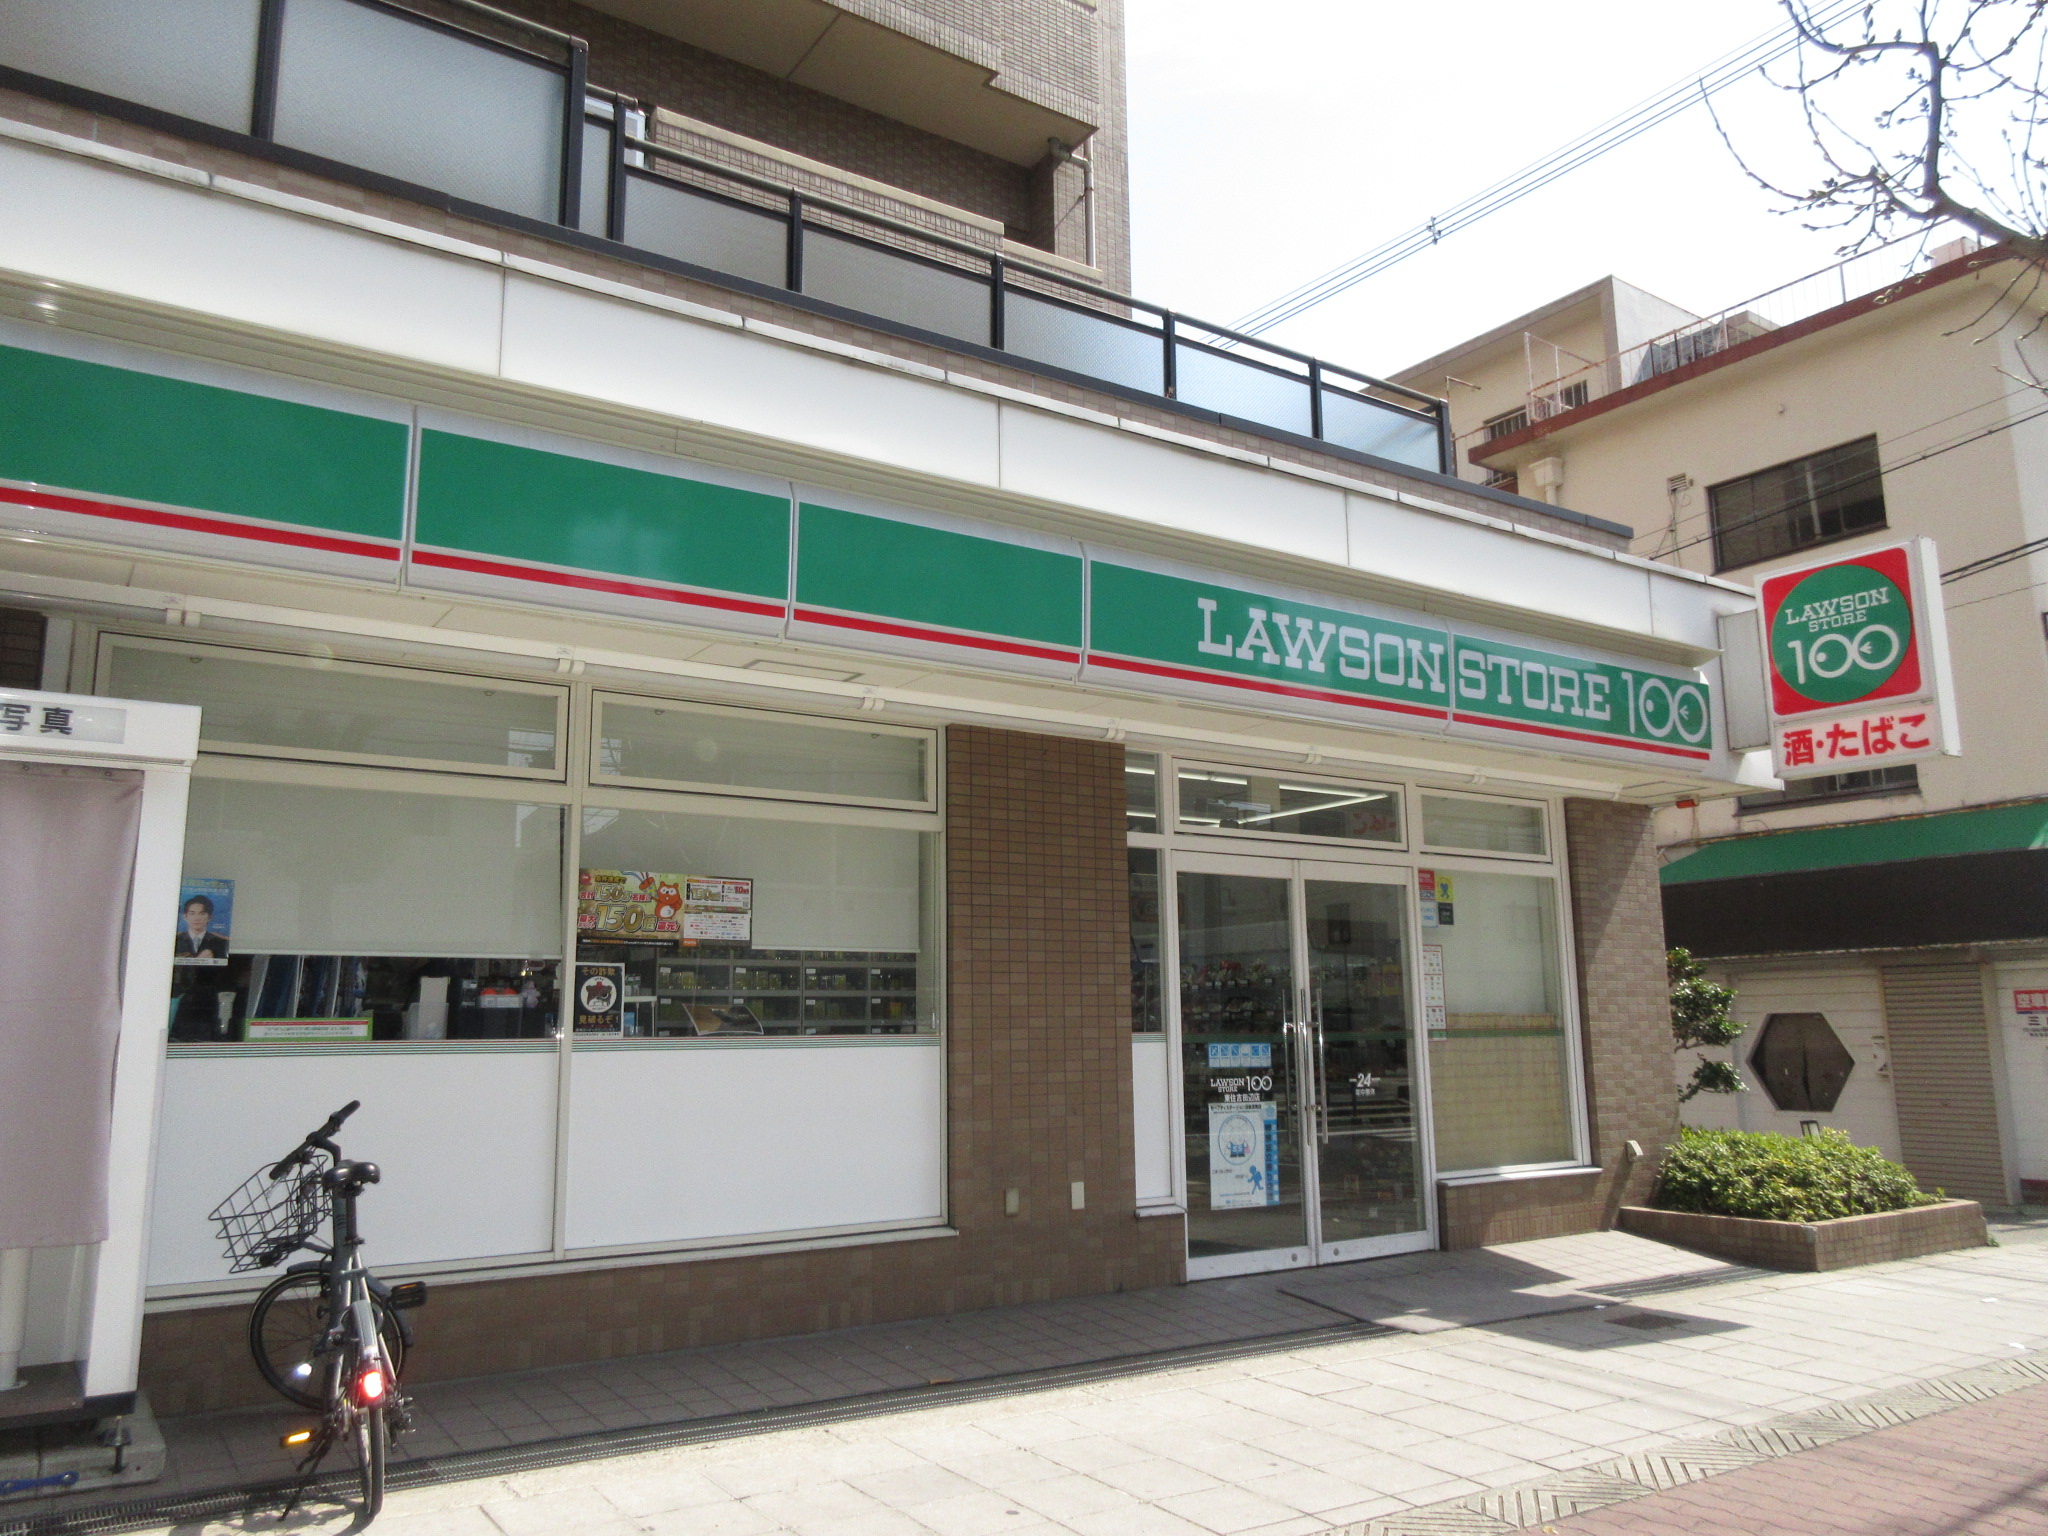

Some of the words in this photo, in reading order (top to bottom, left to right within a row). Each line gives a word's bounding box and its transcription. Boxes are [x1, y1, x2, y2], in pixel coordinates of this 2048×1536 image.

[1785, 587, 1891, 625] LAWSON
[1808, 610, 1867, 632] STORE
[1197, 597, 1448, 693] LAWSON
[1458, 650, 1611, 722] STORE
[1621, 671, 1709, 743] 100
[1787, 624, 1899, 684] 100
[1783, 713, 1930, 767] 酒・たばこ
[1210, 1077, 1245, 1087] LAWSON
[1246, 1075, 1273, 1092] 100
[1356, 1072, 1372, 1088] 24
